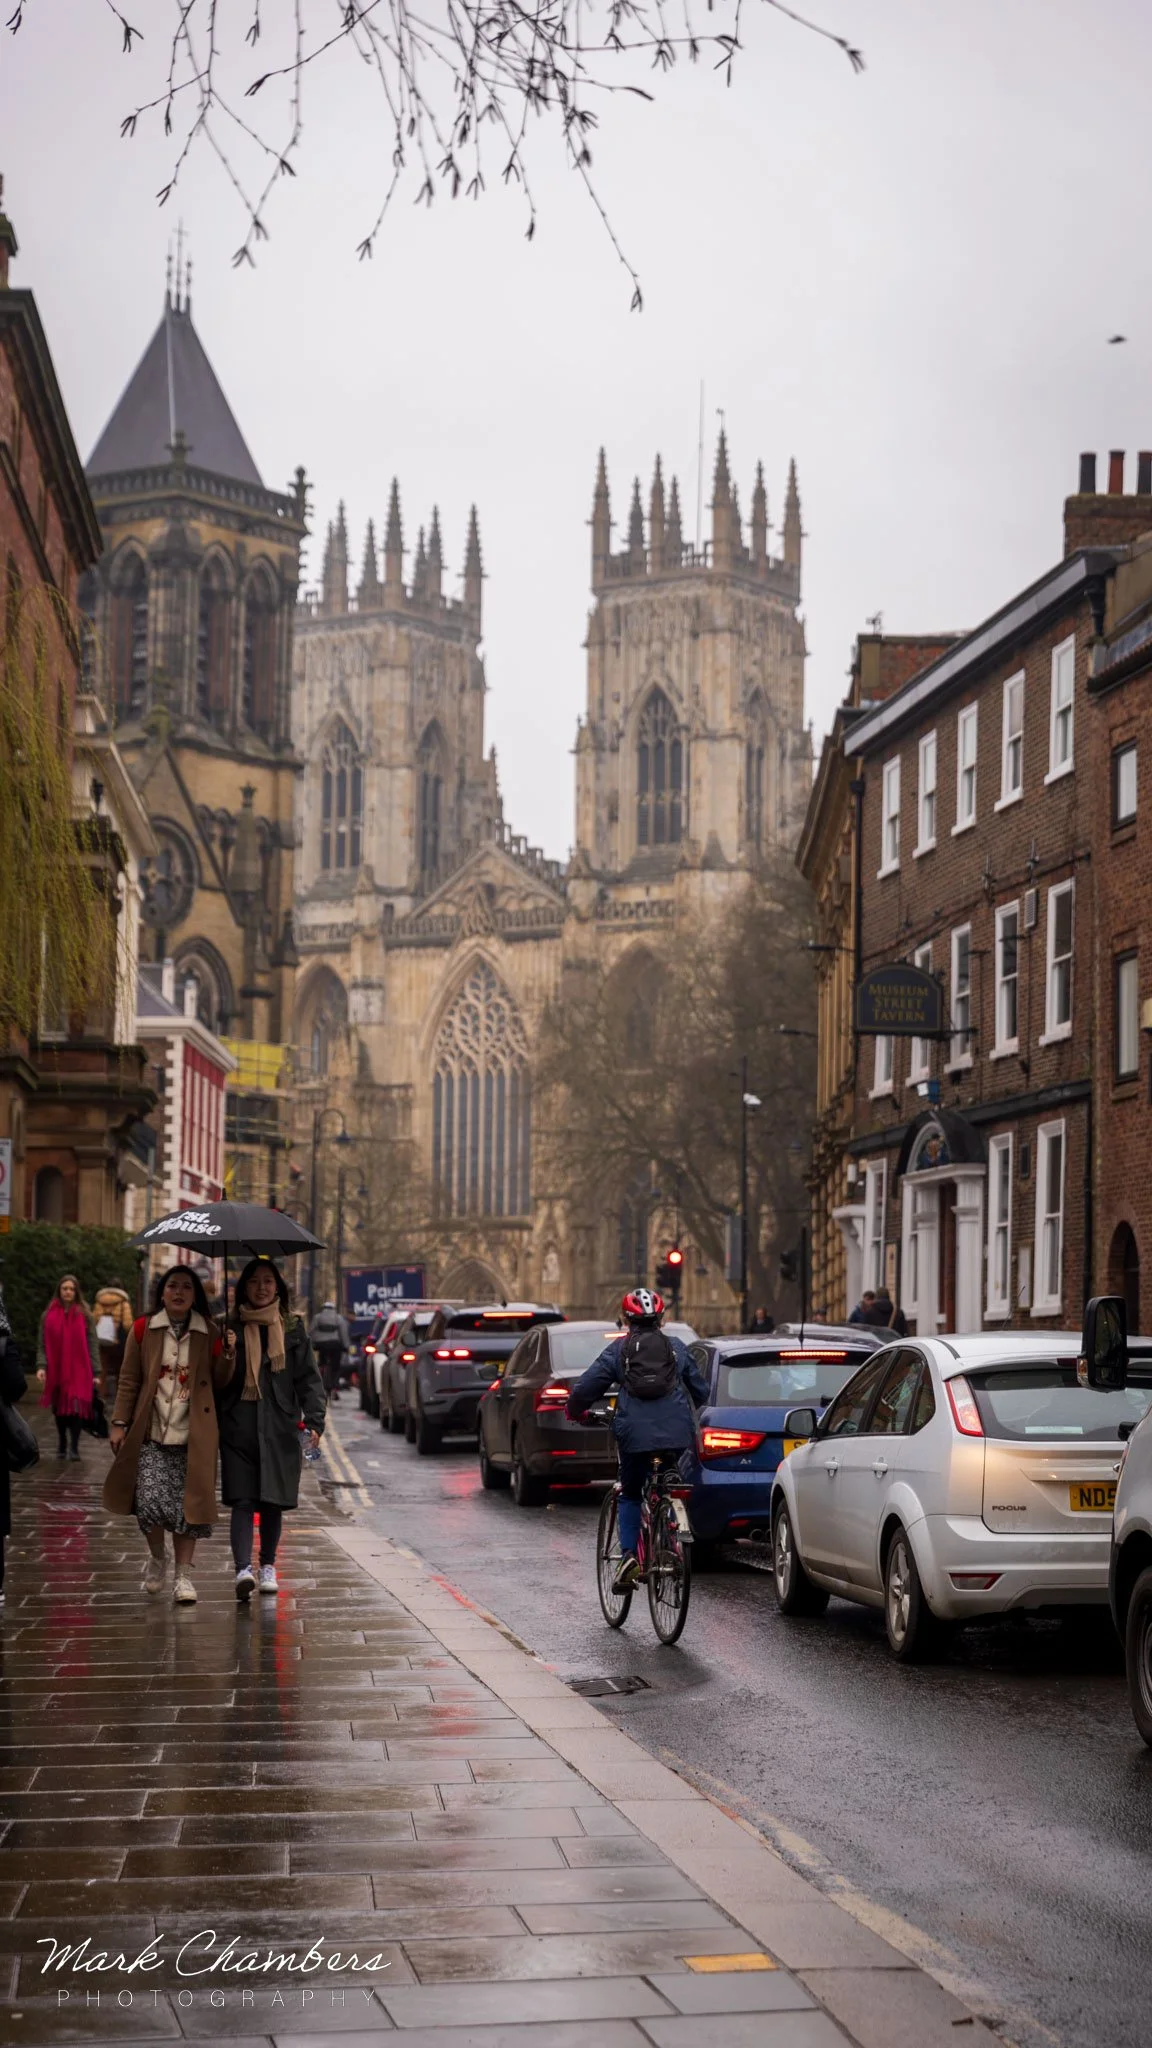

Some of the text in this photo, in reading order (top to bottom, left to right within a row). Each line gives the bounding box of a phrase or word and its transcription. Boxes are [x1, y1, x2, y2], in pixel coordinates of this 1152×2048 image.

[869, 984, 928, 996] MUSEUM
[874, 996, 924, 1009] STREET
[872, 1008, 925, 1021] TAVERN
[367, 1283, 403, 1298] Paul
